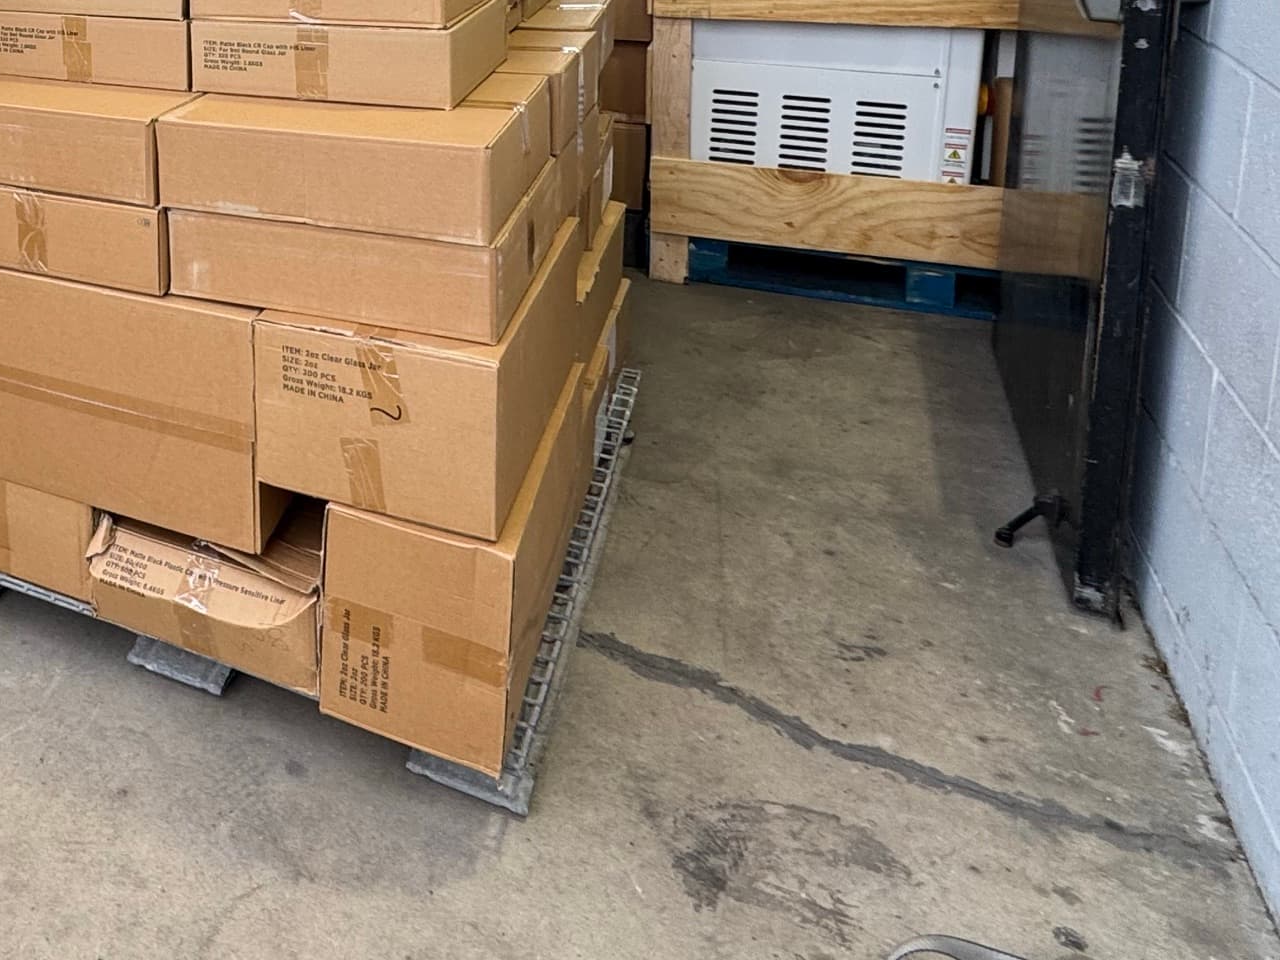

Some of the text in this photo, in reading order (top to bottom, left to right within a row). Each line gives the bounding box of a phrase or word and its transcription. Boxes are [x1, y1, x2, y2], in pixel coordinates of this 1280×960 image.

[282, 345, 303, 357] ITEM:
[321, 353, 342, 364] Clear
[344, 357, 366, 369] Glass
[282, 355, 302, 366] SIZE:
[282, 364, 300, 374] QTY:
[320, 372, 337, 383] PCS
[282, 374, 304, 385] Gross
[306, 378, 336, 392] Weight:
[282, 383, 345, 404] MADE IN CHINA
[240, 586, 269, 601] Sensitive
